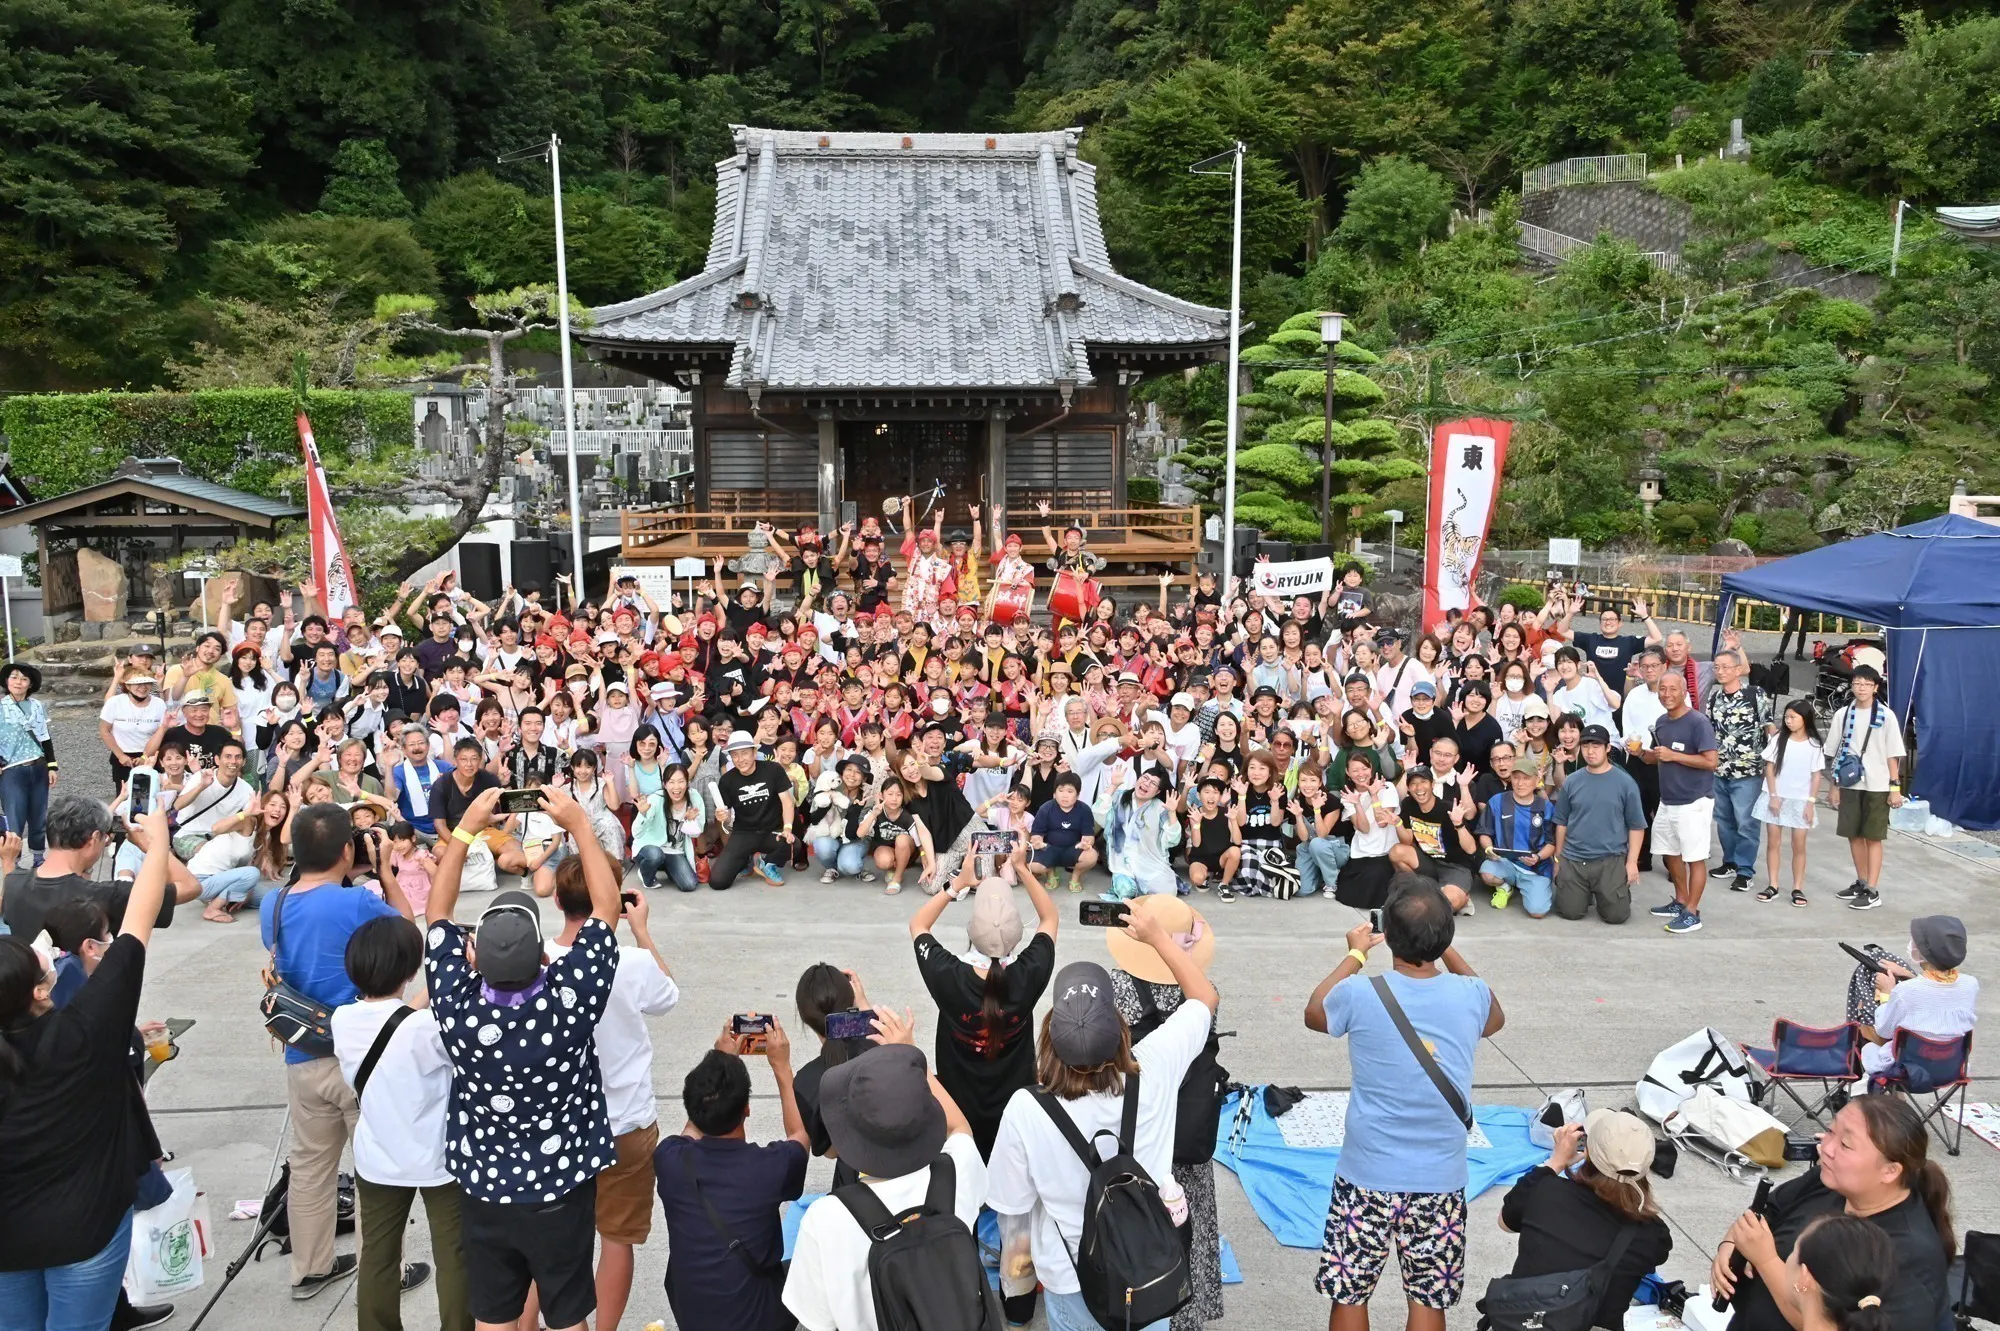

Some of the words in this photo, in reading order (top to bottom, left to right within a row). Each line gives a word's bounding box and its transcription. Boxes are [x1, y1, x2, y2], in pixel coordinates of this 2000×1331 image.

[1461, 444, 1484, 471] 東
[1277, 571, 1324, 588] RYUJIN
[1597, 647, 1618, 656] CHUMS
